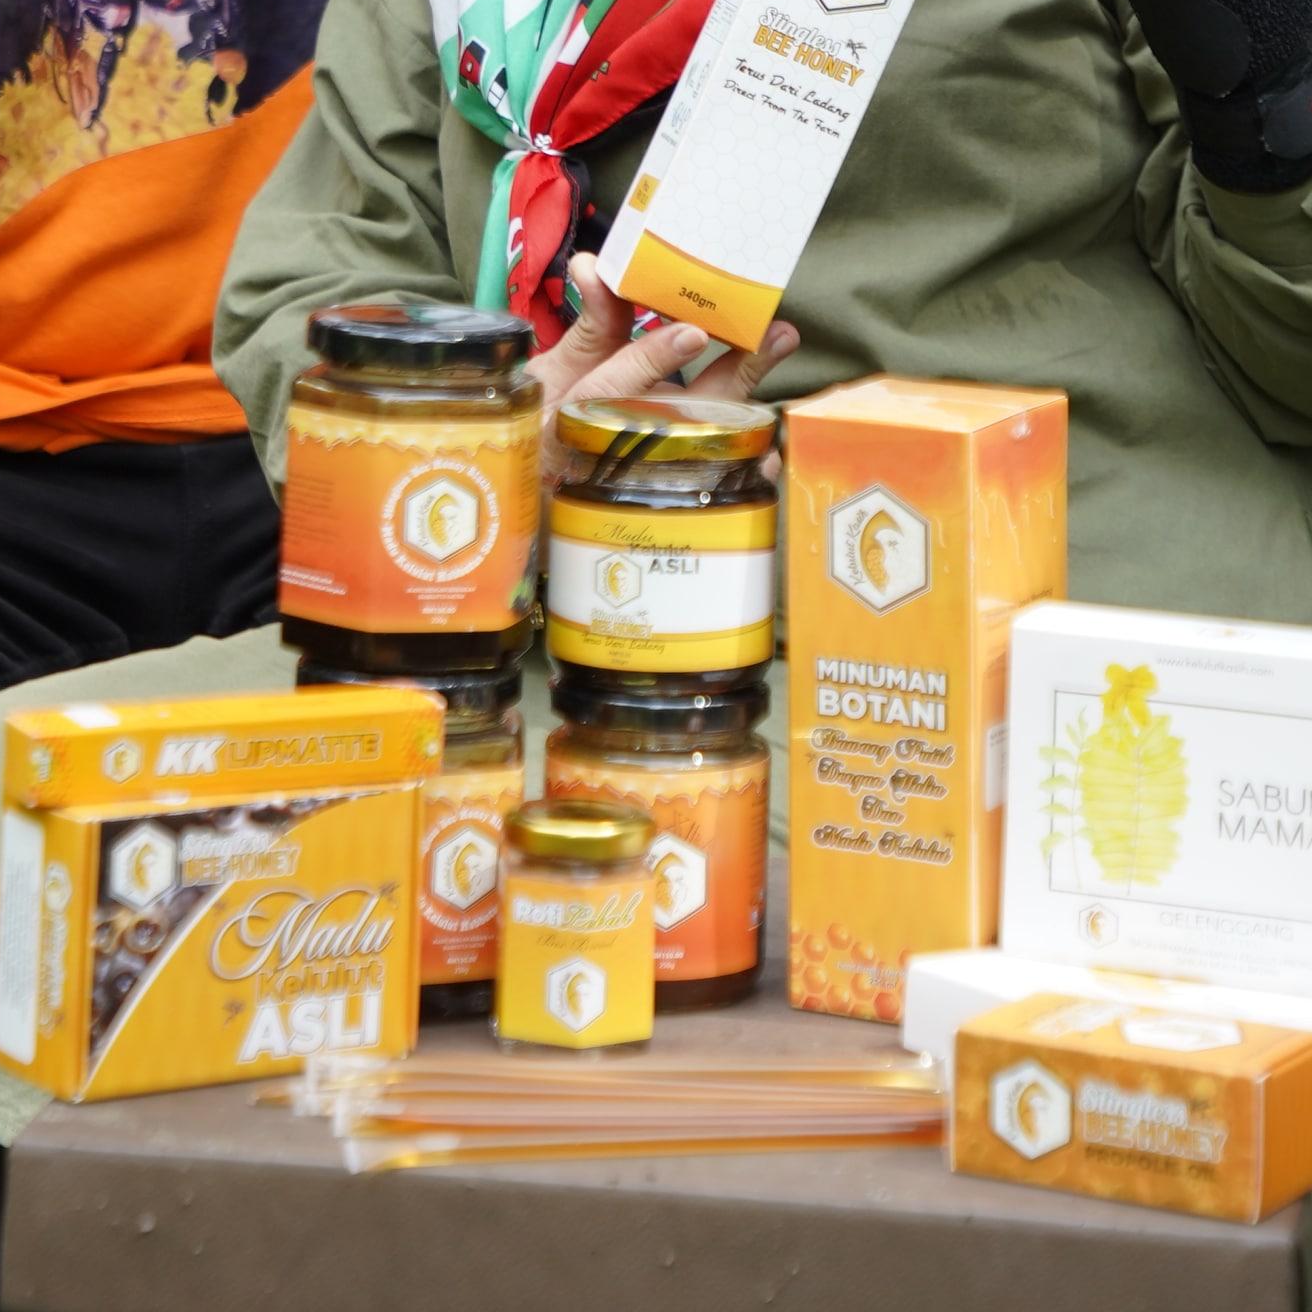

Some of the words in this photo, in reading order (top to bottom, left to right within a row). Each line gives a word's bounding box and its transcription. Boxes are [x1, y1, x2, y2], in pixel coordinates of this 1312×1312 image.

[752, 24, 796, 58] BEE
[793, 43, 865, 87] HONEY
[735, 58, 765, 81] Terus
[769, 74, 802, 97] Dari
[803, 87, 851, 122] Ladang
[792, 108, 810, 125] The
[678, 286, 717, 311] 340gm
[648, 558, 700, 575] ASLI
[816, 657, 947, 697] MINUMAN
[816, 687, 947, 731] BOTANI
[155, 736, 227, 778] KK
[209, 887, 394, 982] Madu
[237, 990, 383, 1064] ASLI
